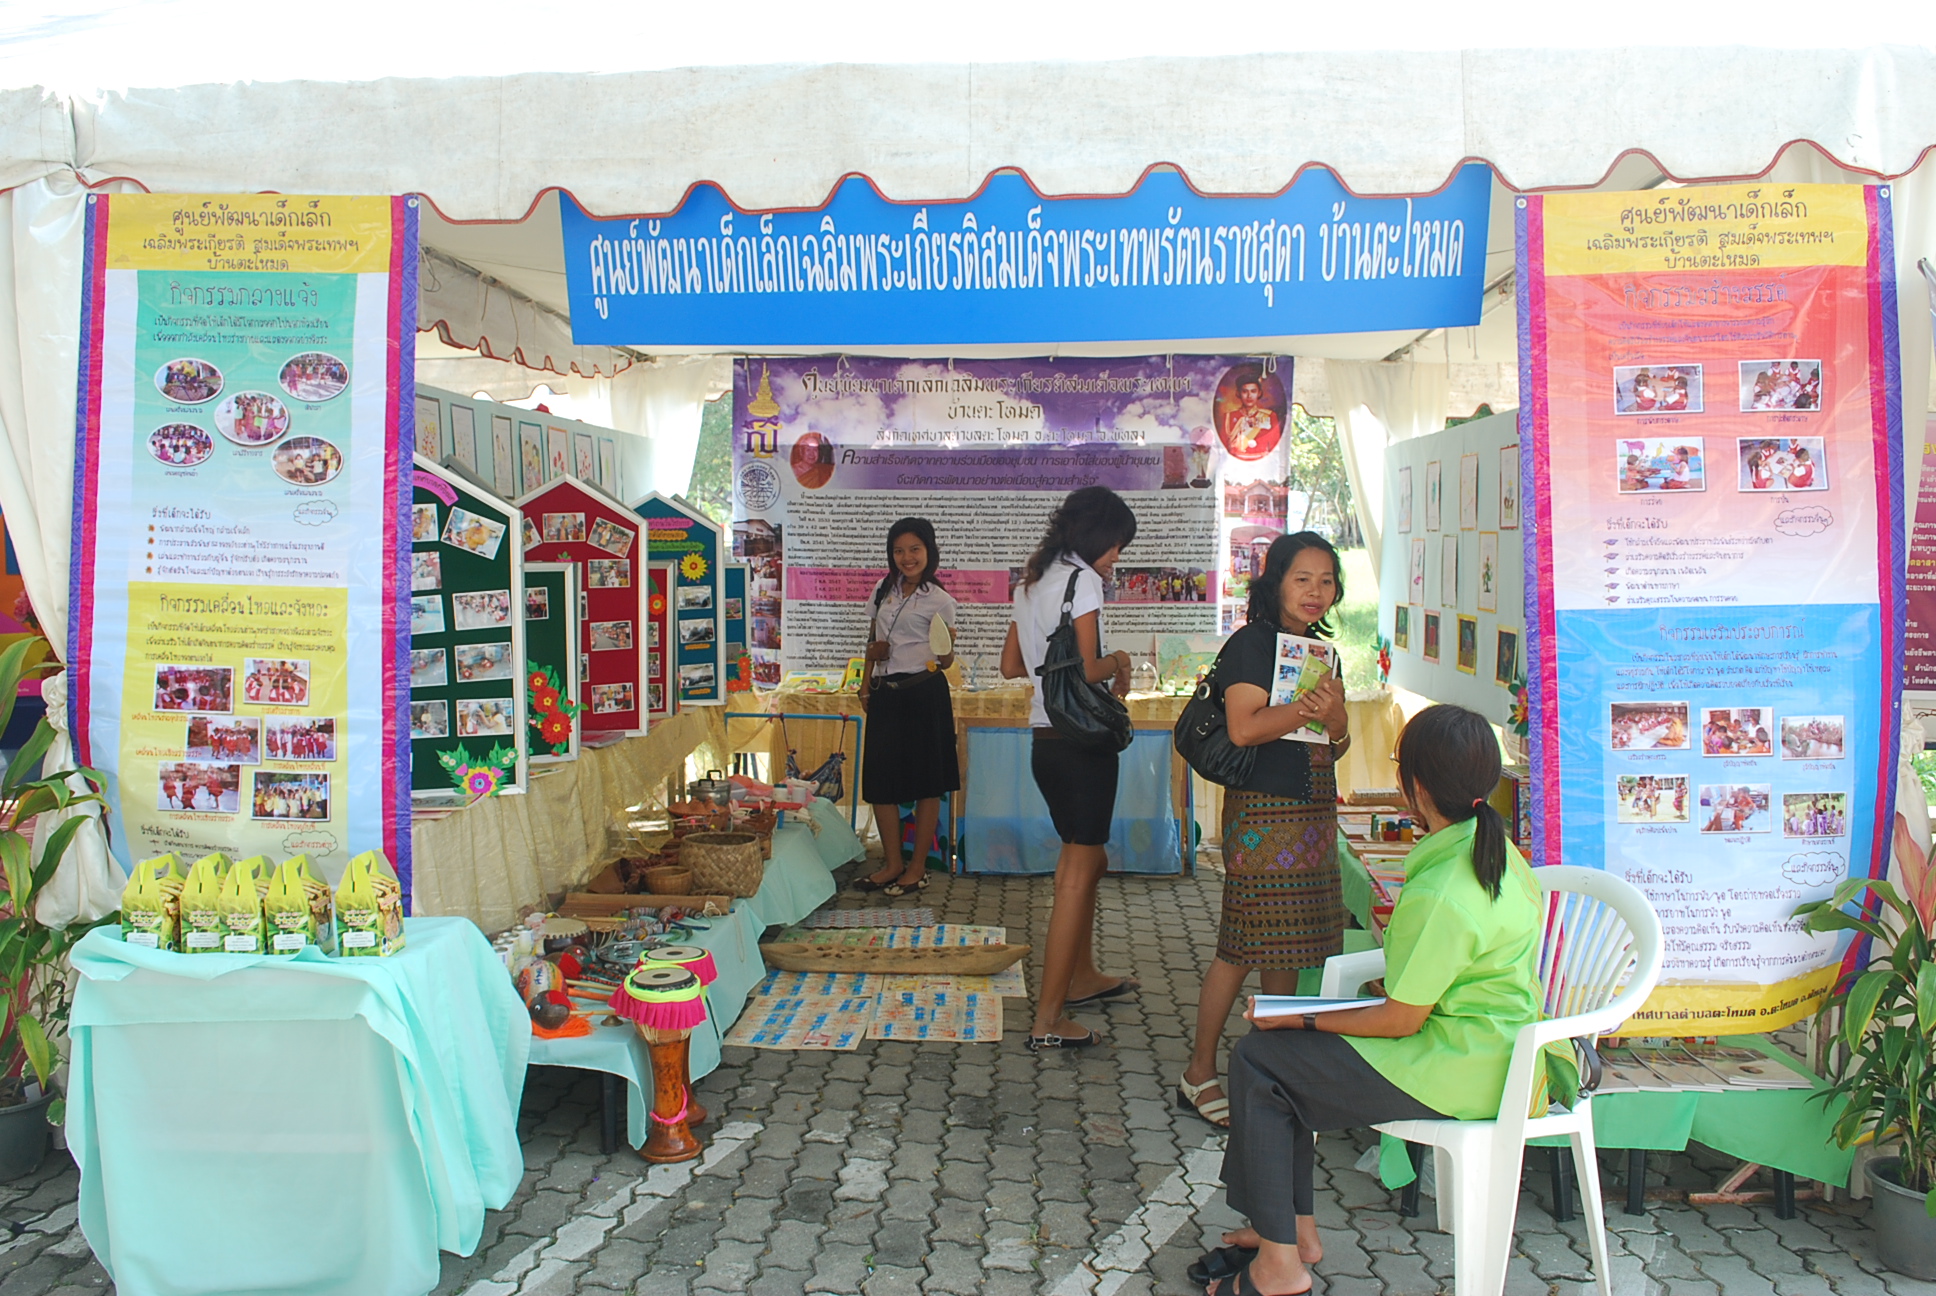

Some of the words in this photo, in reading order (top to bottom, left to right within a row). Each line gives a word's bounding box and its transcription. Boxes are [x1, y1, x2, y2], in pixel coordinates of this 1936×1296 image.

[172, 200, 331, 236] ศูนย์พัฒนาเด็กเล็ก
[1620, 188, 1807, 234] ศูนย์พัฒนาเด็กเล็ก
[143, 233, 245, 252] เฉลิมพระเกียรติ
[253, 231, 359, 252] สมเด็จพระเทพฯ
[1587, 228, 1709, 253] เฉลิมพระเกียรติ
[1718, 223, 1834, 248] สมเด็จพระเทพฯ
[206, 252, 289, 271] บ้านตะโหมด
[590, 205, 1305, 319] ศูนย์พัฒนาเด็กเล็กเฉลิมพระเกียรติสมเด็จพระเทพรัตนราชสุดา
[1664, 245, 1761, 269] บ้านตะโหมด
[170, 282, 318, 307] กิจกรรมกลางแจ้ง
[1624, 273, 1787, 308] กิจกรรมสร้างสรรค์
[948, 398, 1041, 420] บ้านตะโหมด
[1659, 618, 1806, 641] กิจกรรมเสริมประสบการณ์
[1625, 868, 1693, 884] สิ่งที่เด็กจะได้รับ
